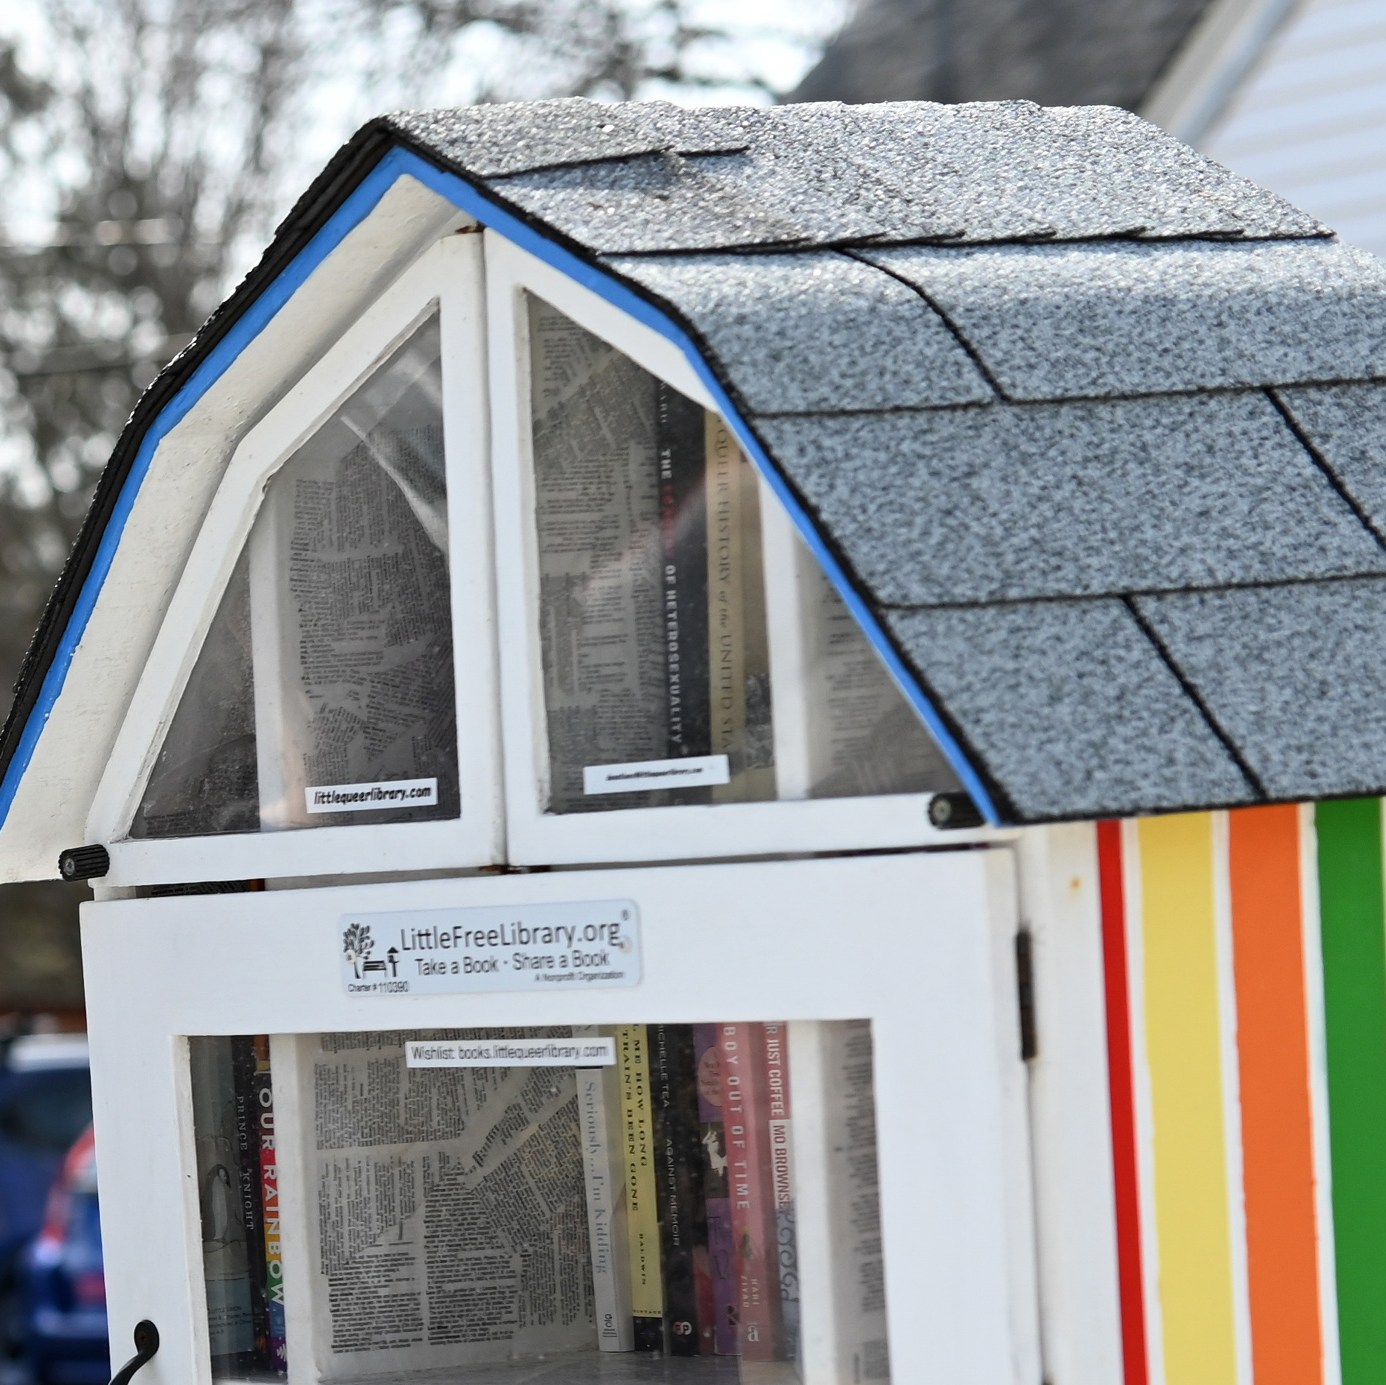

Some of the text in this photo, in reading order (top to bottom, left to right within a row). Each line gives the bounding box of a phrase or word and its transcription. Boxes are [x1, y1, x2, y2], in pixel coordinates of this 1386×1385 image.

[661, 449, 672, 480] THE
[717, 500, 730, 584] HISTORY
[665, 565, 676, 584] OF
[666, 590, 682, 743] HETEROSEXUALITY
[720, 635, 732, 709] UNITED
[314, 787, 431, 805] littlequeerlibrary.com
[400, 920, 621, 951] LittleFreeLibrary.org
[414, 950, 610, 976] Take a Book Share a Book
[458, 1044, 609, 1062] books.littlequeerlibrary.com
[633, 1040, 641, 1064] ME
[766, 1040, 780, 1066] JUST
[636, 1073, 644, 1111] HOW
[662, 1084, 670, 1108] TEA
[768, 1069, 784, 1116] COFFEE
[627, 1109, 635, 1154] BEEN
[724, 1026, 750, 1209] BOY OUT OF TIME
[773, 1124, 785, 1144] MO
[236, 1096, 254, 1230] PRINCE KNIGHT
[638, 1119, 647, 1167] LONG
[666, 1139, 676, 1191] AGAINST
[259, 1087, 285, 1306] OUR RAINBOW
[630, 1163, 638, 1211] GONE
[595, 1209, 609, 1274] Kidding
[670, 1194, 680, 1246] MEMOIR
